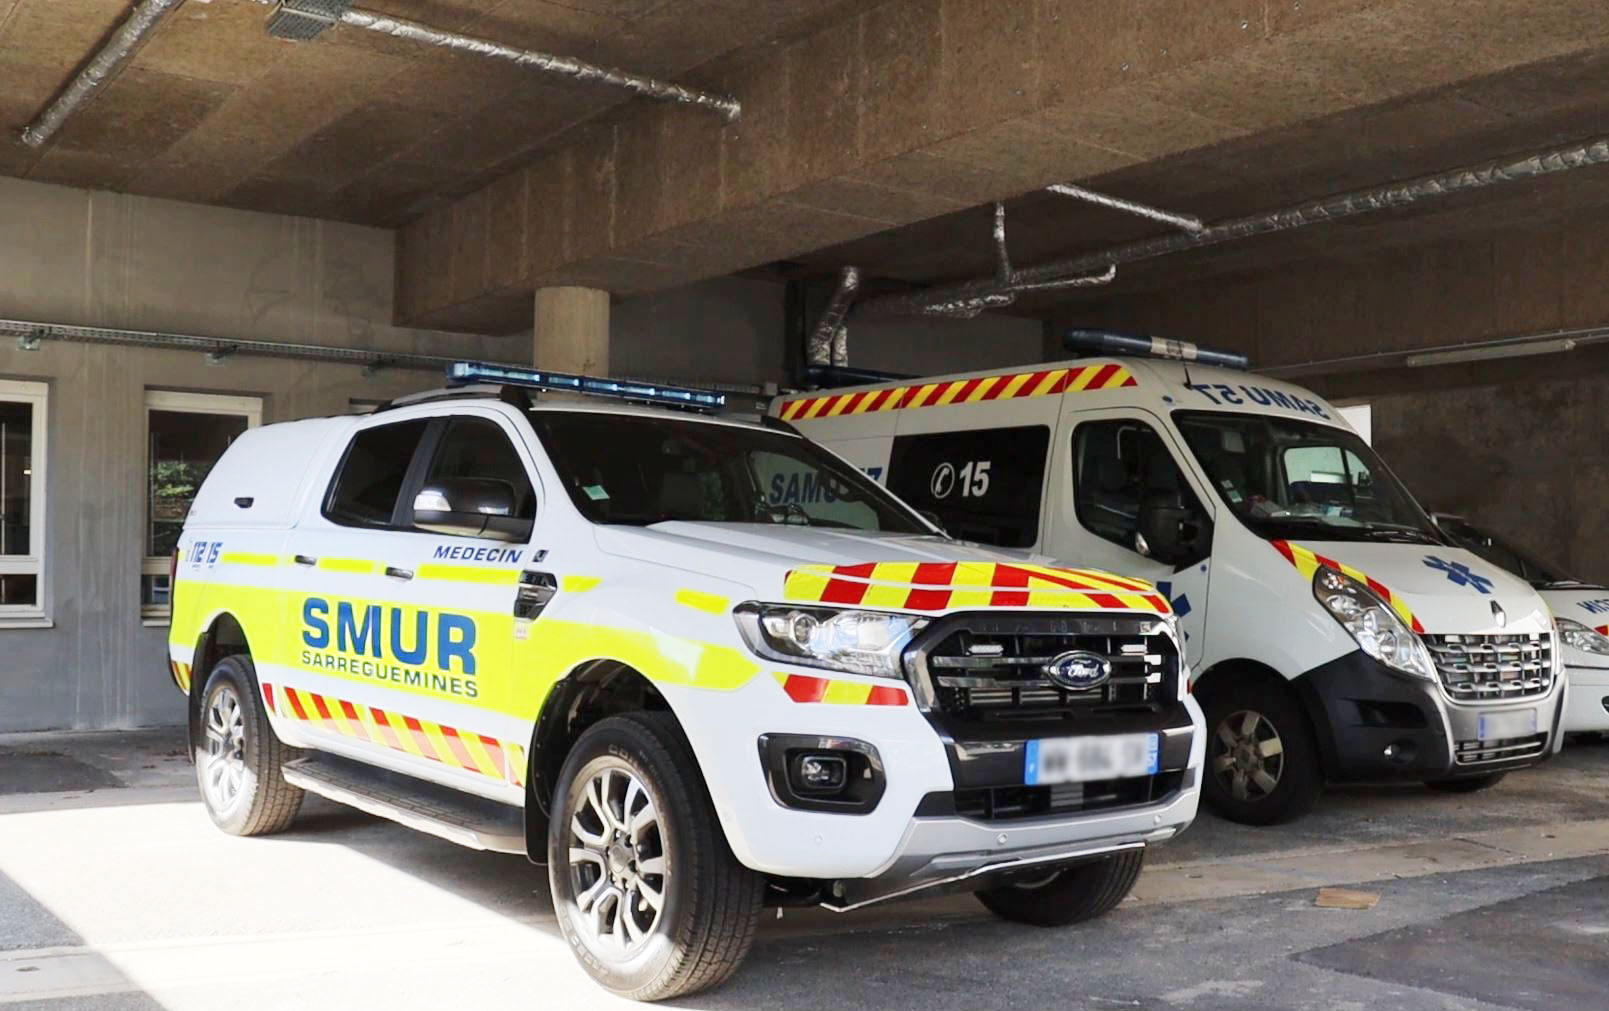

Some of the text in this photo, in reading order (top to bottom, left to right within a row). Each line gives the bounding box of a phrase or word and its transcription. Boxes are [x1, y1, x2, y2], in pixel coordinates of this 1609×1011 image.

[958, 460, 990, 498] 15
[207, 541, 223, 563] 15
[433, 545, 523, 563] MEDECIN
[302, 597, 476, 676] SMUR
[302, 650, 478, 698] SARREGUEMINES
[1067, 658, 1100, 678] Ford
